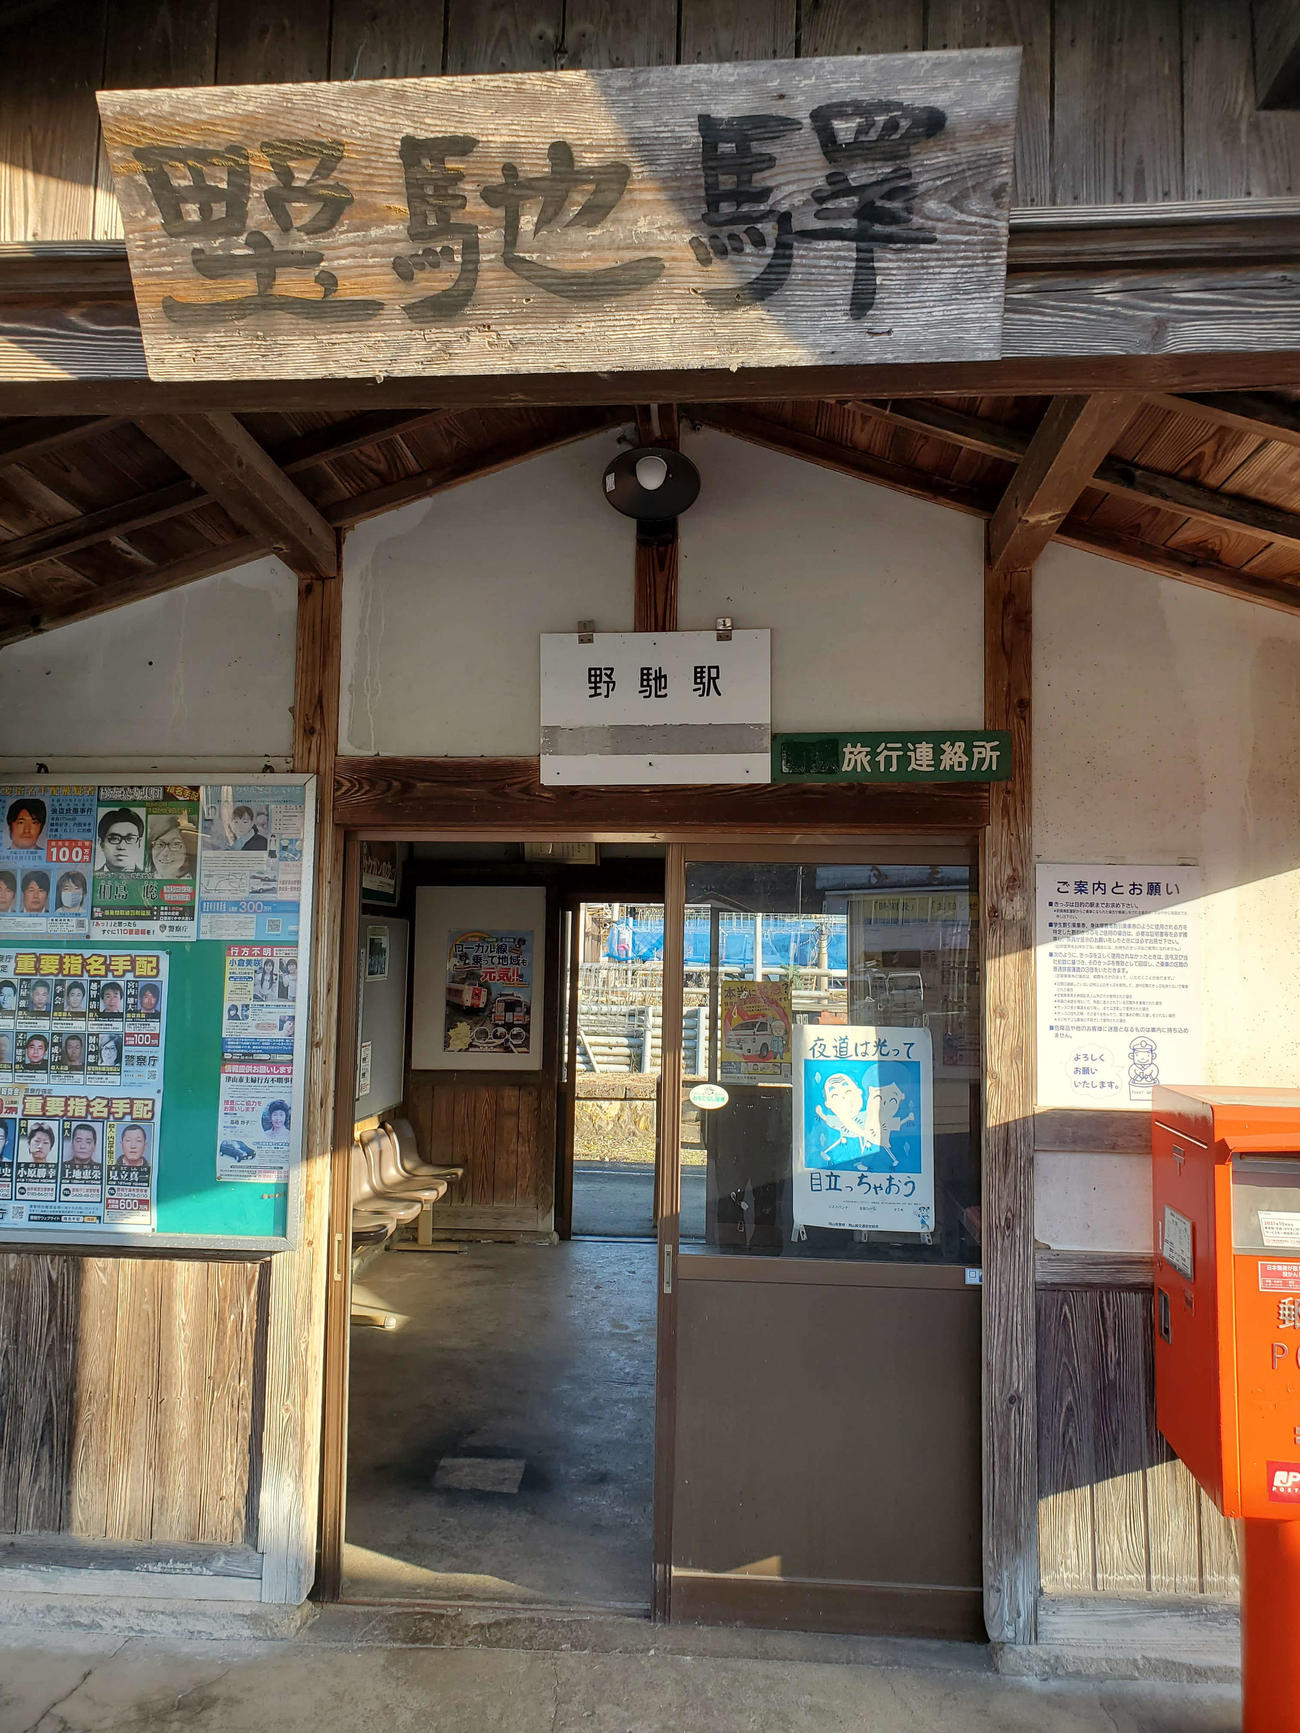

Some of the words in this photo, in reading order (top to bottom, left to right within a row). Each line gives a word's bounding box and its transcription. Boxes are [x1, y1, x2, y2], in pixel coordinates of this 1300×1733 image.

[587, 665, 722, 699] 野馳駅
[842, 741, 1000, 772] 旅行連絡所
[1056, 880, 1180, 896] ご案内とお願い
[230, 947, 271, 956] 行方不明
[454, 943, 508, 954] ローカル線
[15, 953, 160, 977] 重要指名手配
[809, 1036, 916, 1059] 夜道は光って
[125, 1055, 159, 1067] 警察庁
[1073, 1053, 1105, 1061] よろしく
[1073, 1067, 1098, 1075] お願い
[1073, 1080, 1119, 1090] いたします。
[22, 1095, 155, 1120] 重要指名手配
[810, 1171, 916, 1197] 目立っちゃおう
